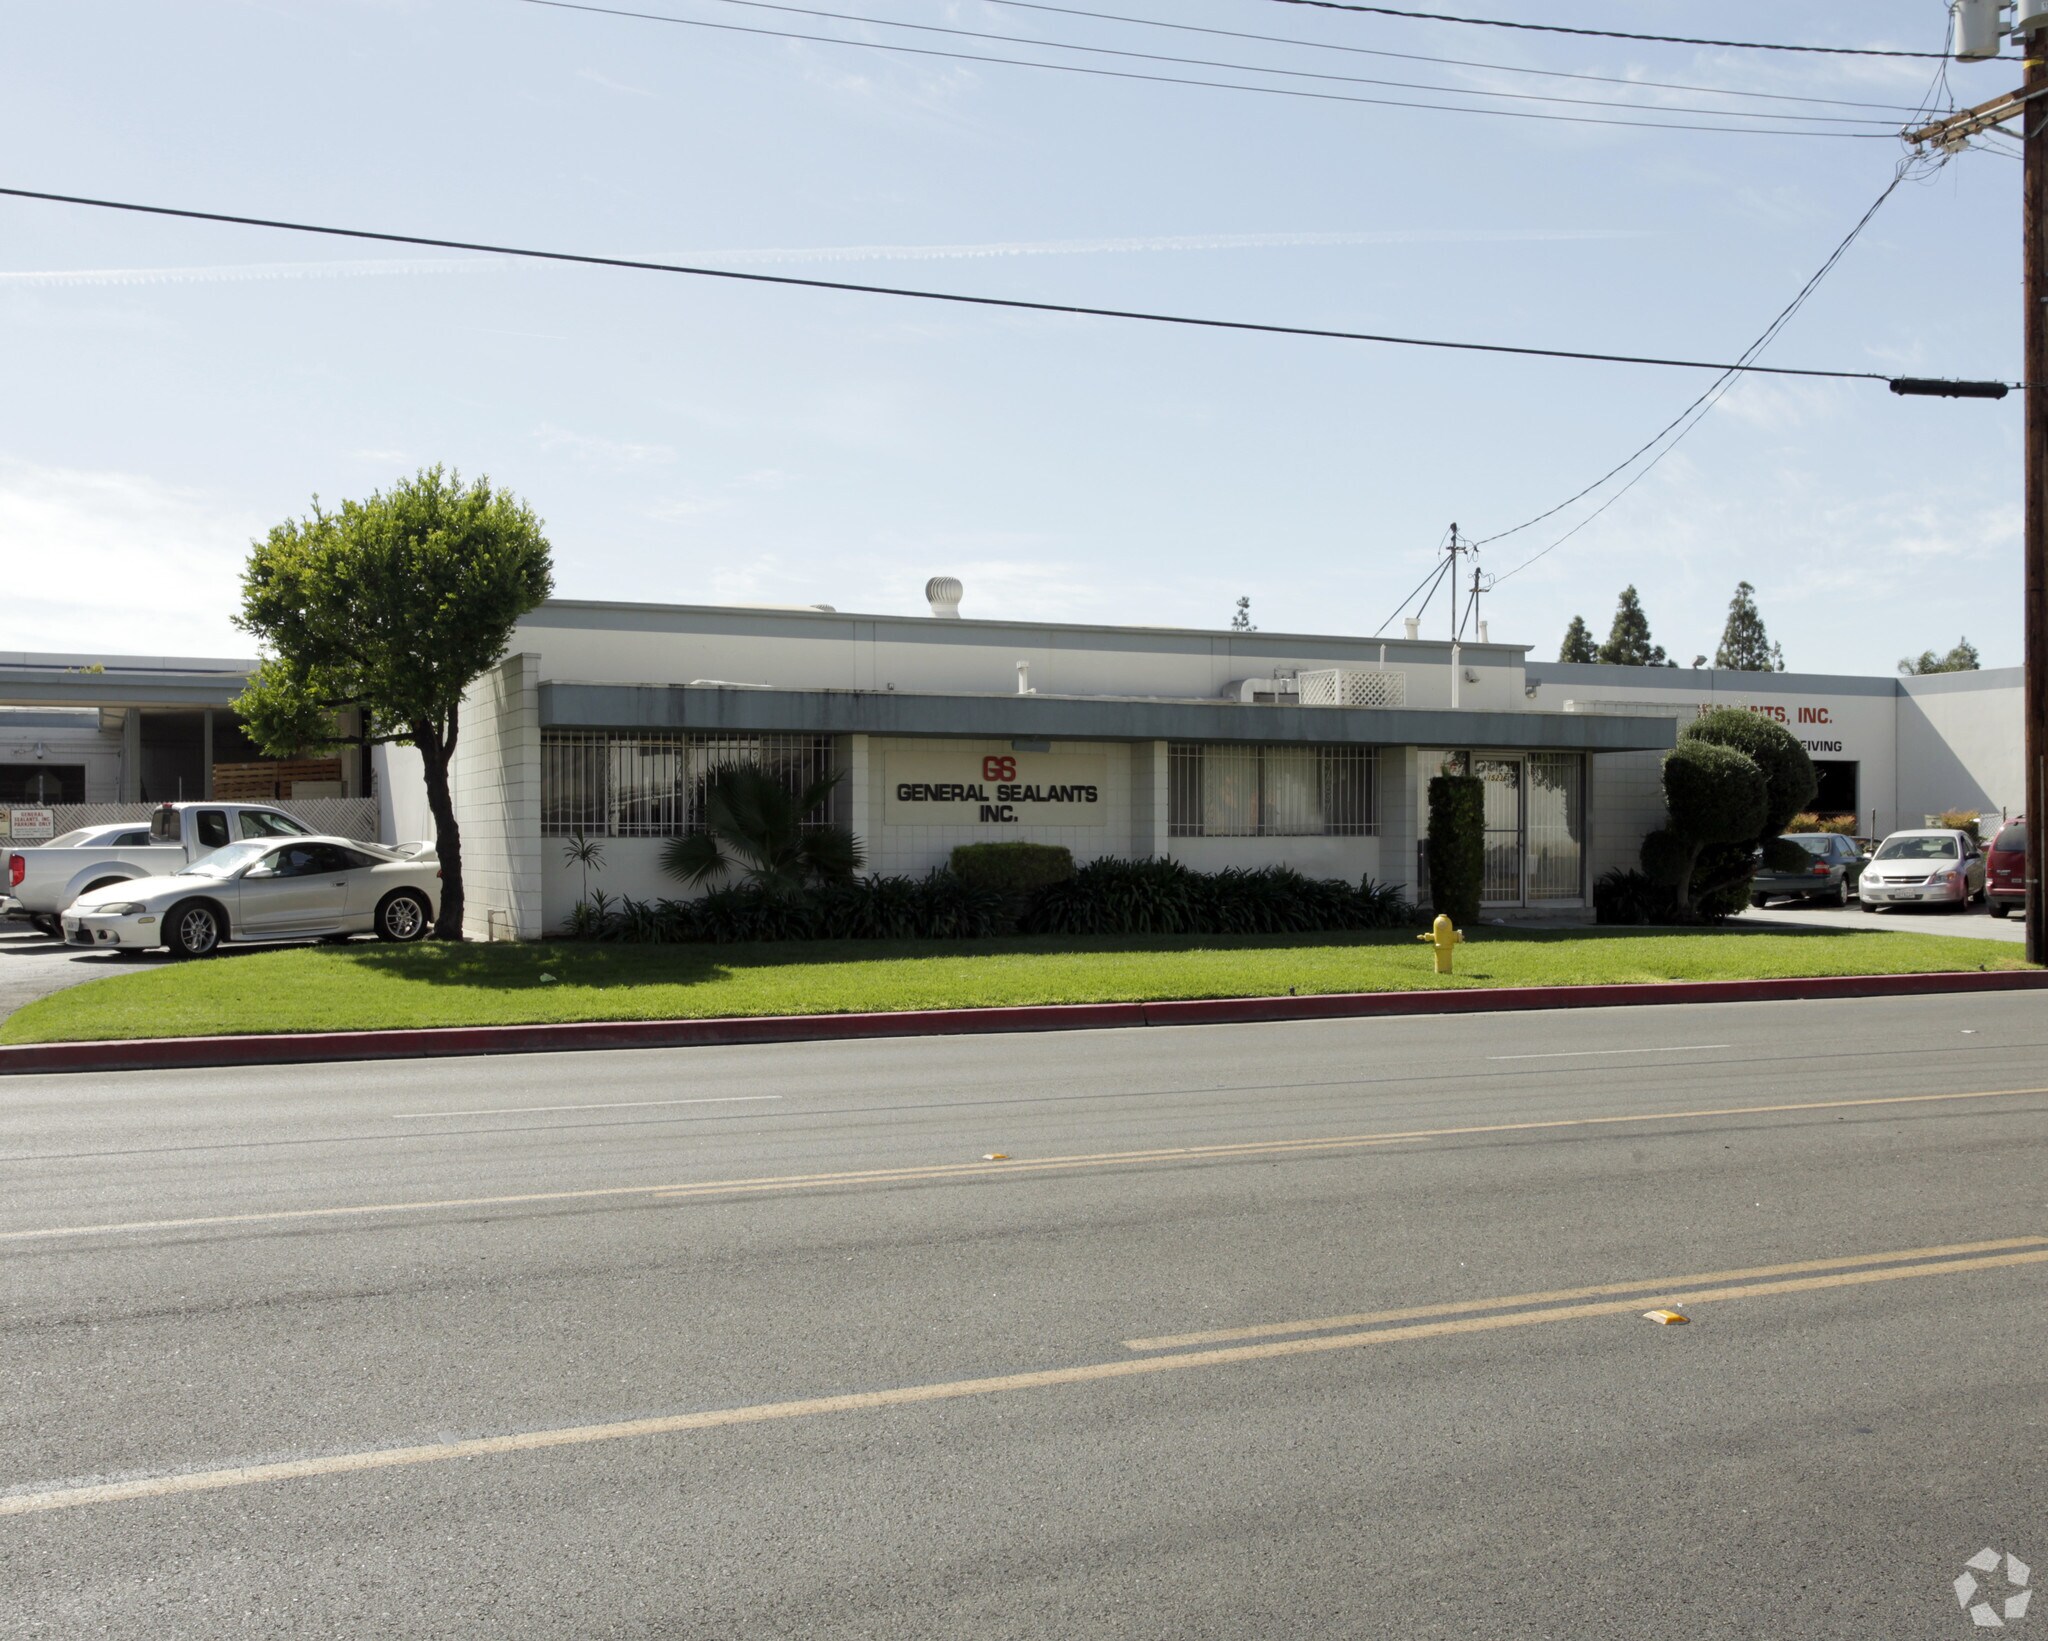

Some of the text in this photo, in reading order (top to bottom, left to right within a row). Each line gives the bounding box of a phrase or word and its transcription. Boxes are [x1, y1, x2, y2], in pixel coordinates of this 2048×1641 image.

[1798, 707, 1833, 724] INC.
[983, 756, 1016, 782] GS
[897, 783, 1098, 803] GENERAL SEALANTS
[979, 804, 1018, 822] INC.
